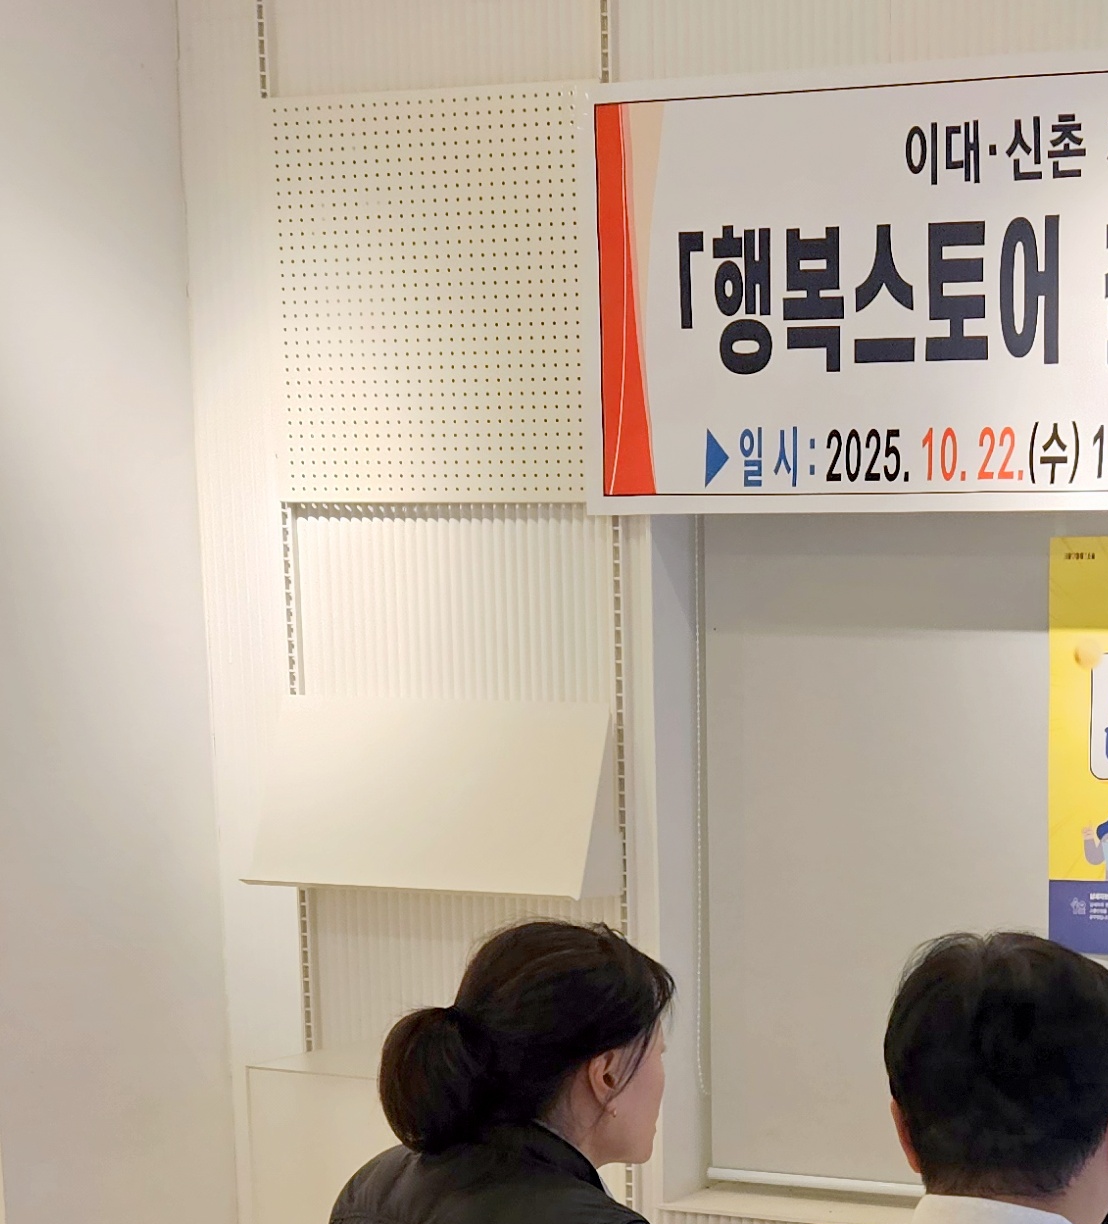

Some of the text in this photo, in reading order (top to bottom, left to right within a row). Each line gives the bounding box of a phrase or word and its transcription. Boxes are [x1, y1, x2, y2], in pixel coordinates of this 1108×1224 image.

[905, 113, 1087, 186] 이대·신촌
[678, 214, 1061, 376] 「행복스토어
[825, 428, 910, 483] 2025.
[921, 426, 967, 482] 10.
